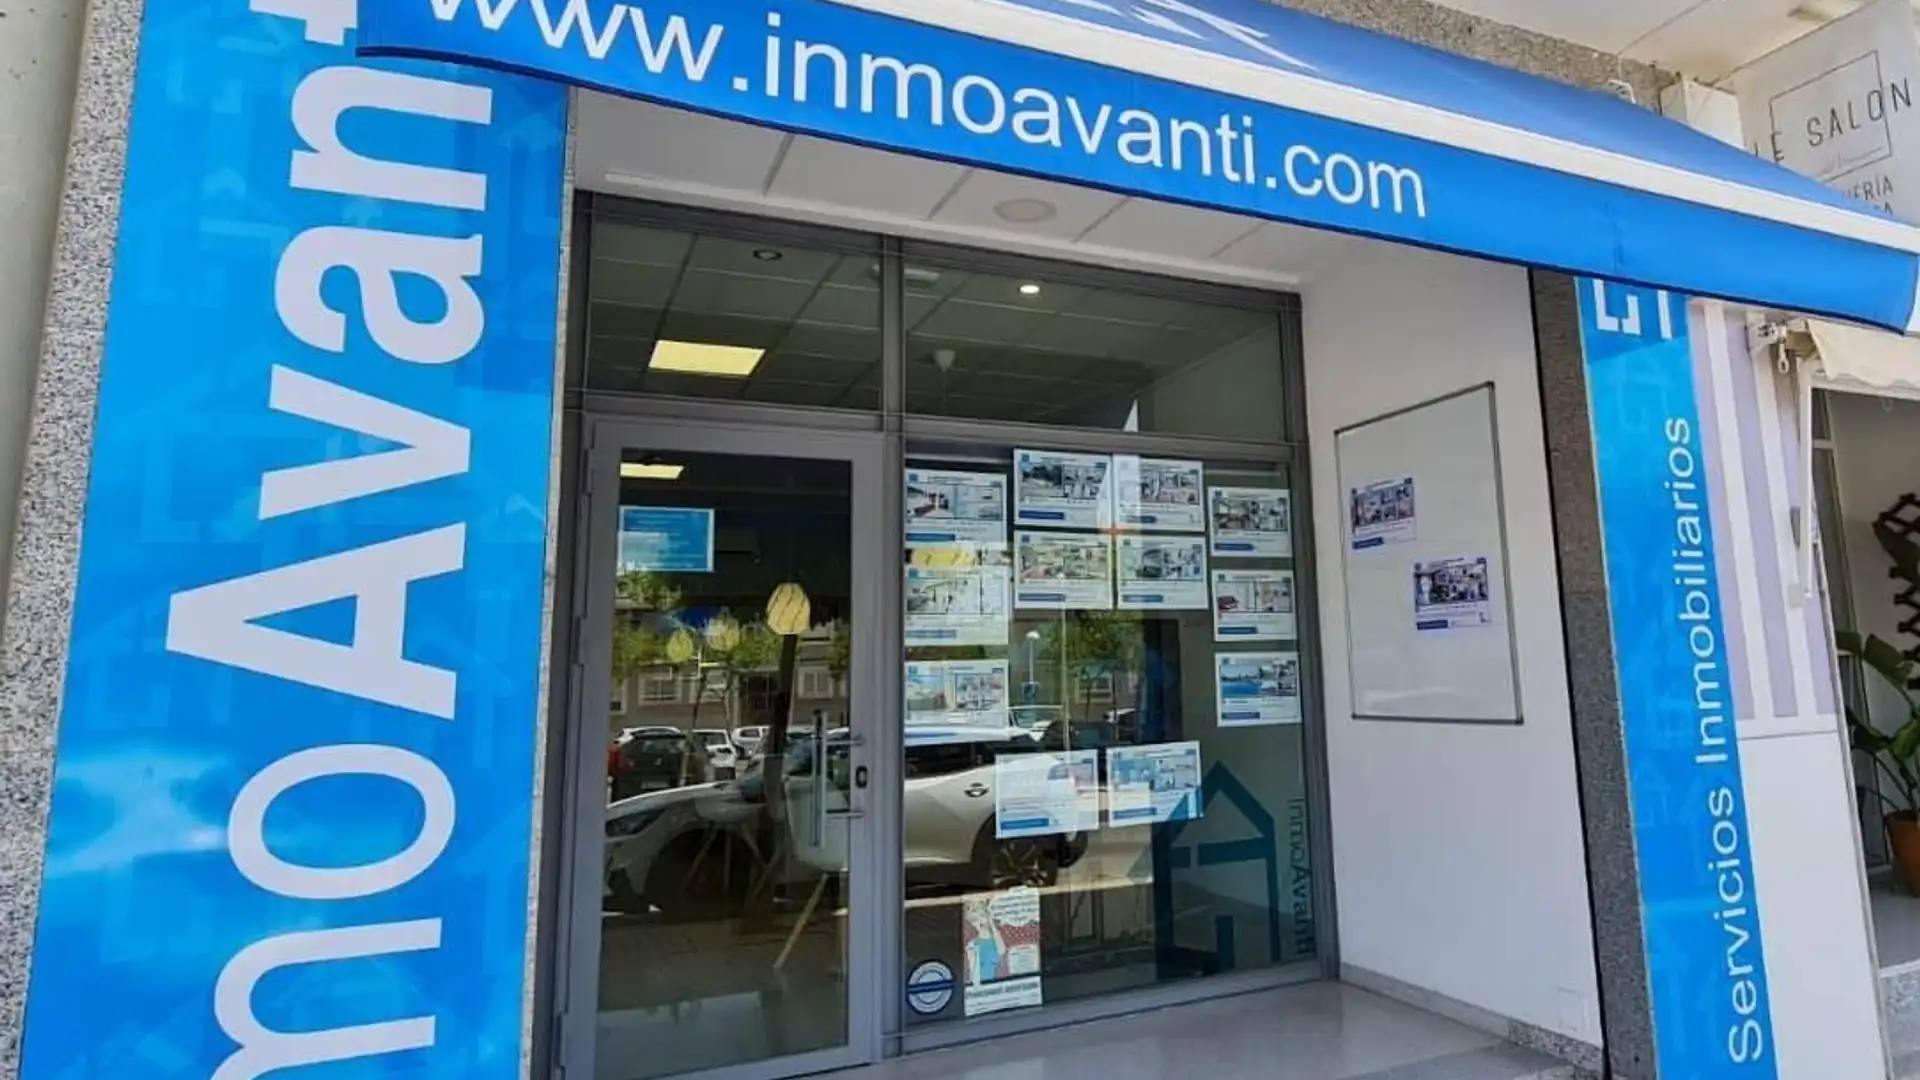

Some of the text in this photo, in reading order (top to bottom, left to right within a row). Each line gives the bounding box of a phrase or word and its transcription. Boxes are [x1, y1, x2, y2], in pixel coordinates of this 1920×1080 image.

[1805, 77, 1912, 147] SALON
[1664, 417, 1763, 1063] Servicios Inmobiliarios
